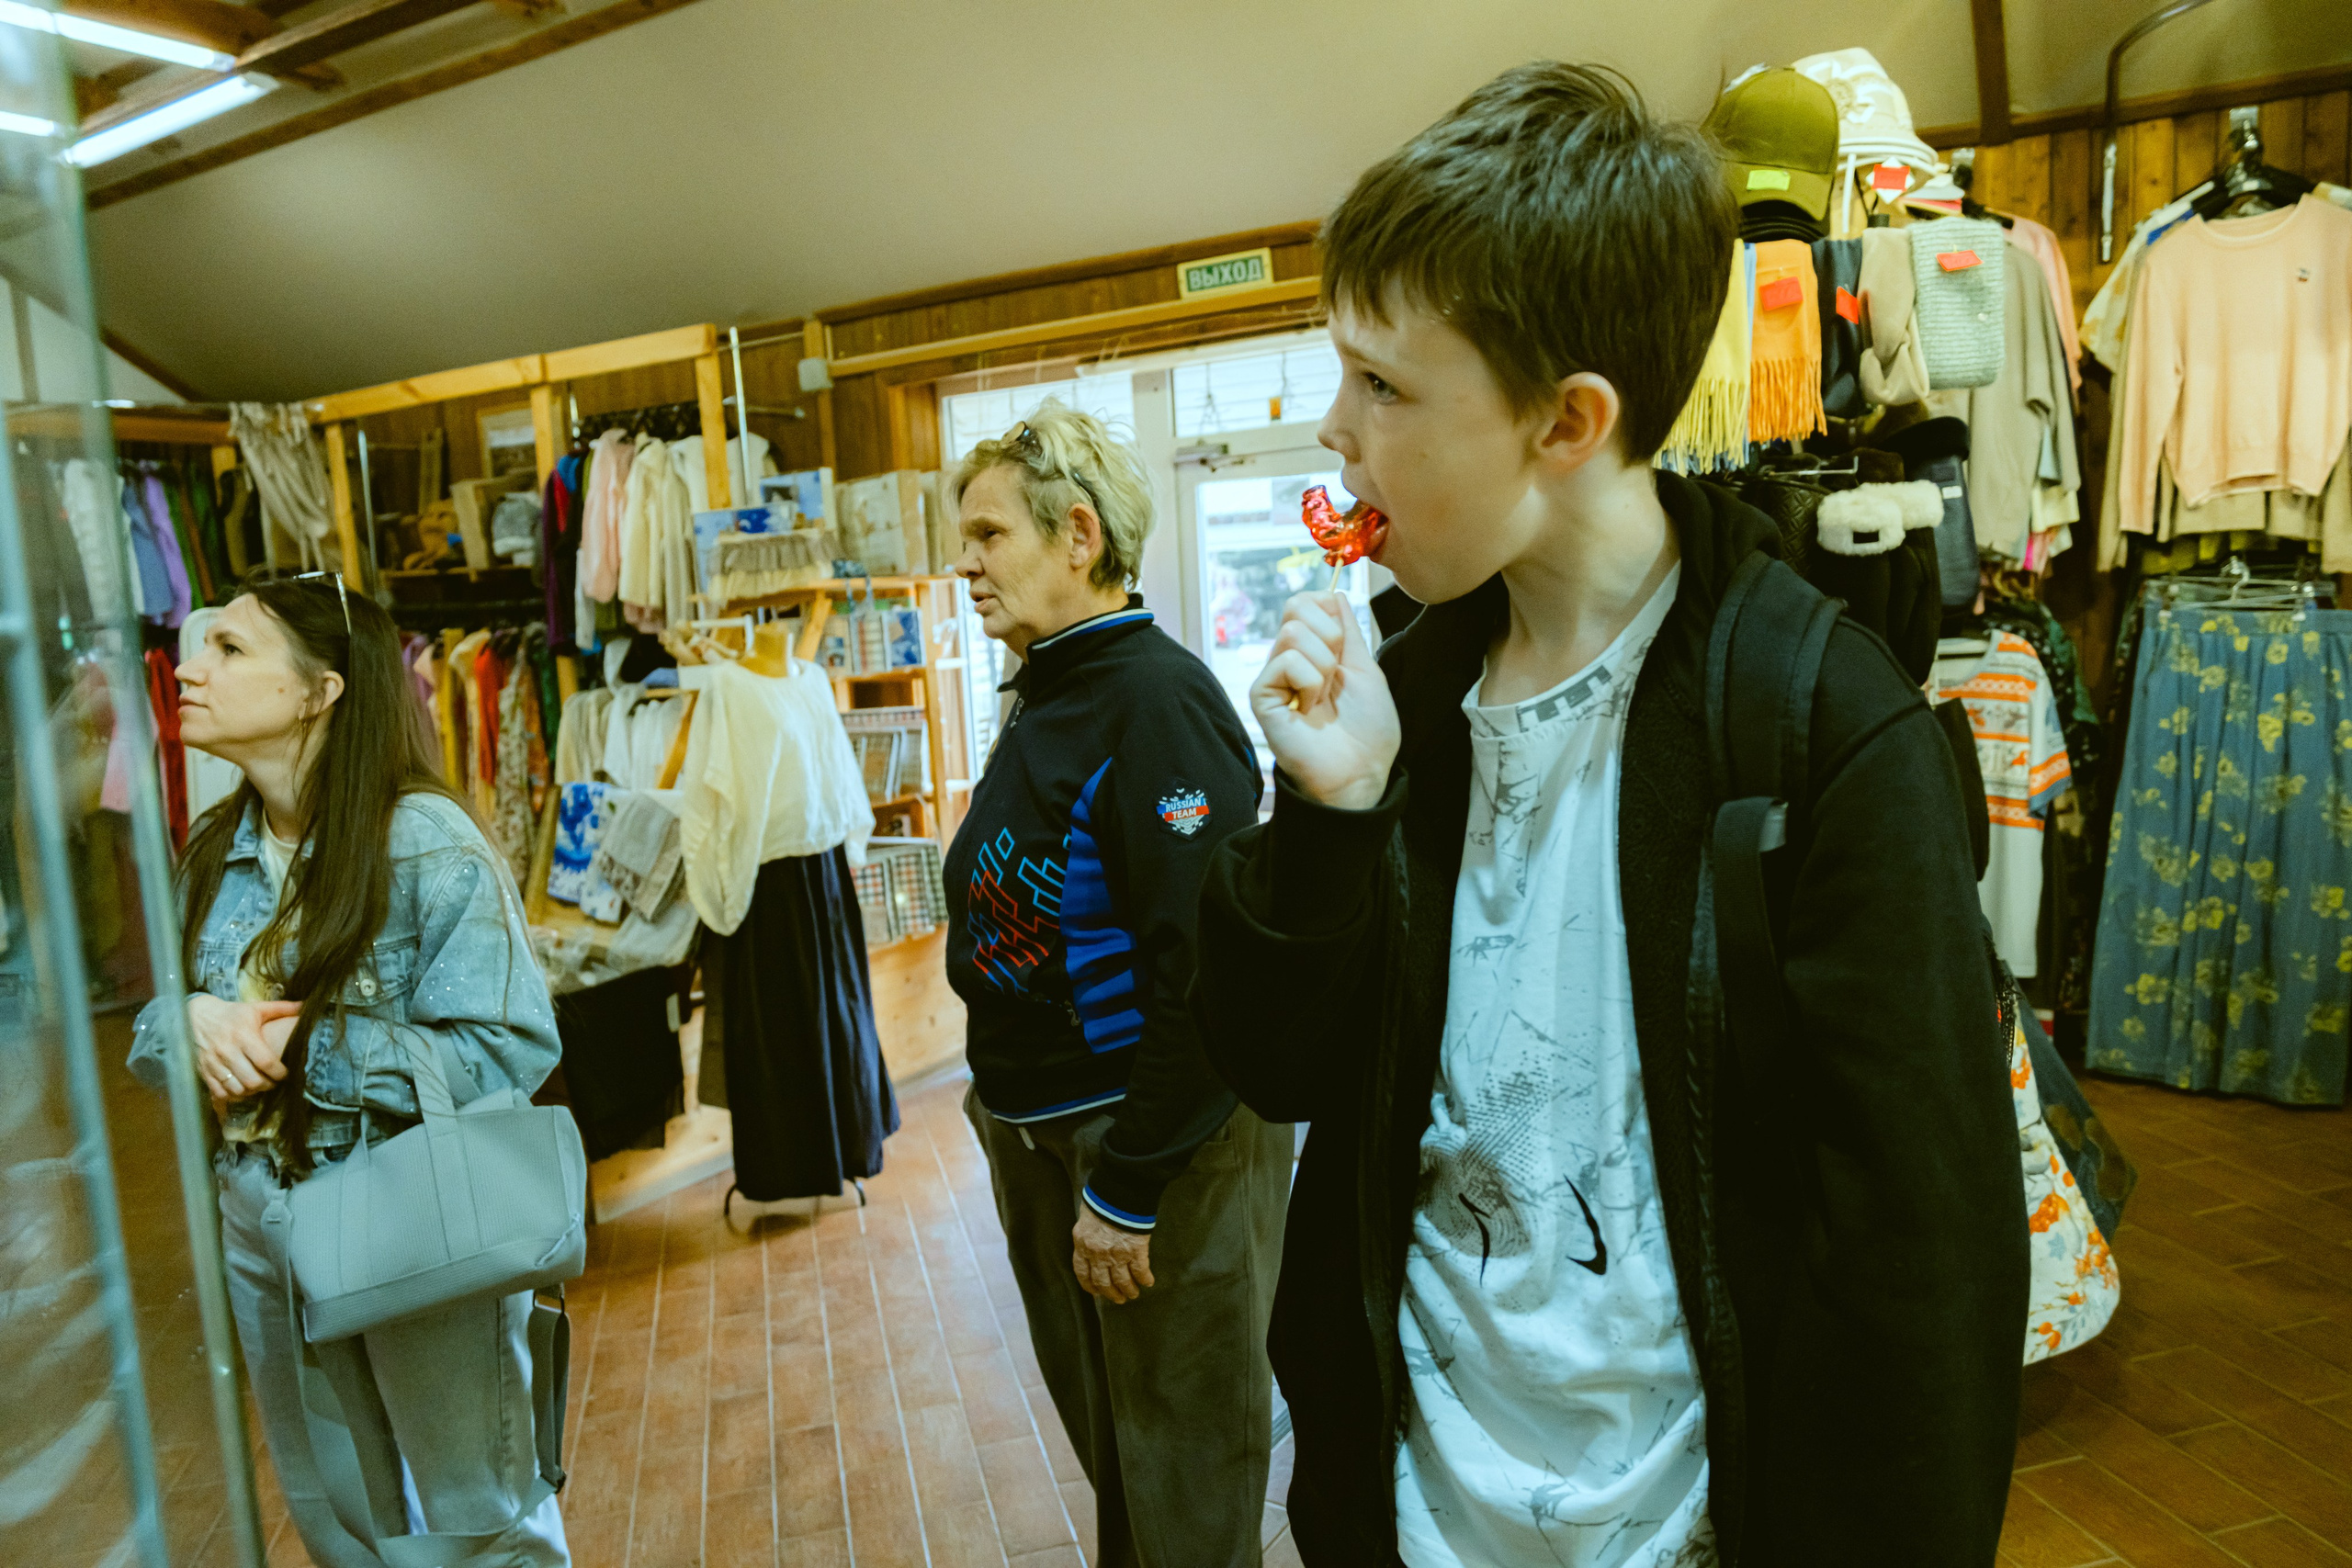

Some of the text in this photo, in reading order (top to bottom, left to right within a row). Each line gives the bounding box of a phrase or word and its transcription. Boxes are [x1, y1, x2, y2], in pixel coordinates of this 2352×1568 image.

[1189, 258, 1262, 289] ВЫХОД
[1165, 797, 1202, 813] RUSSIAN
[1172, 807, 1197, 819] TEAM
